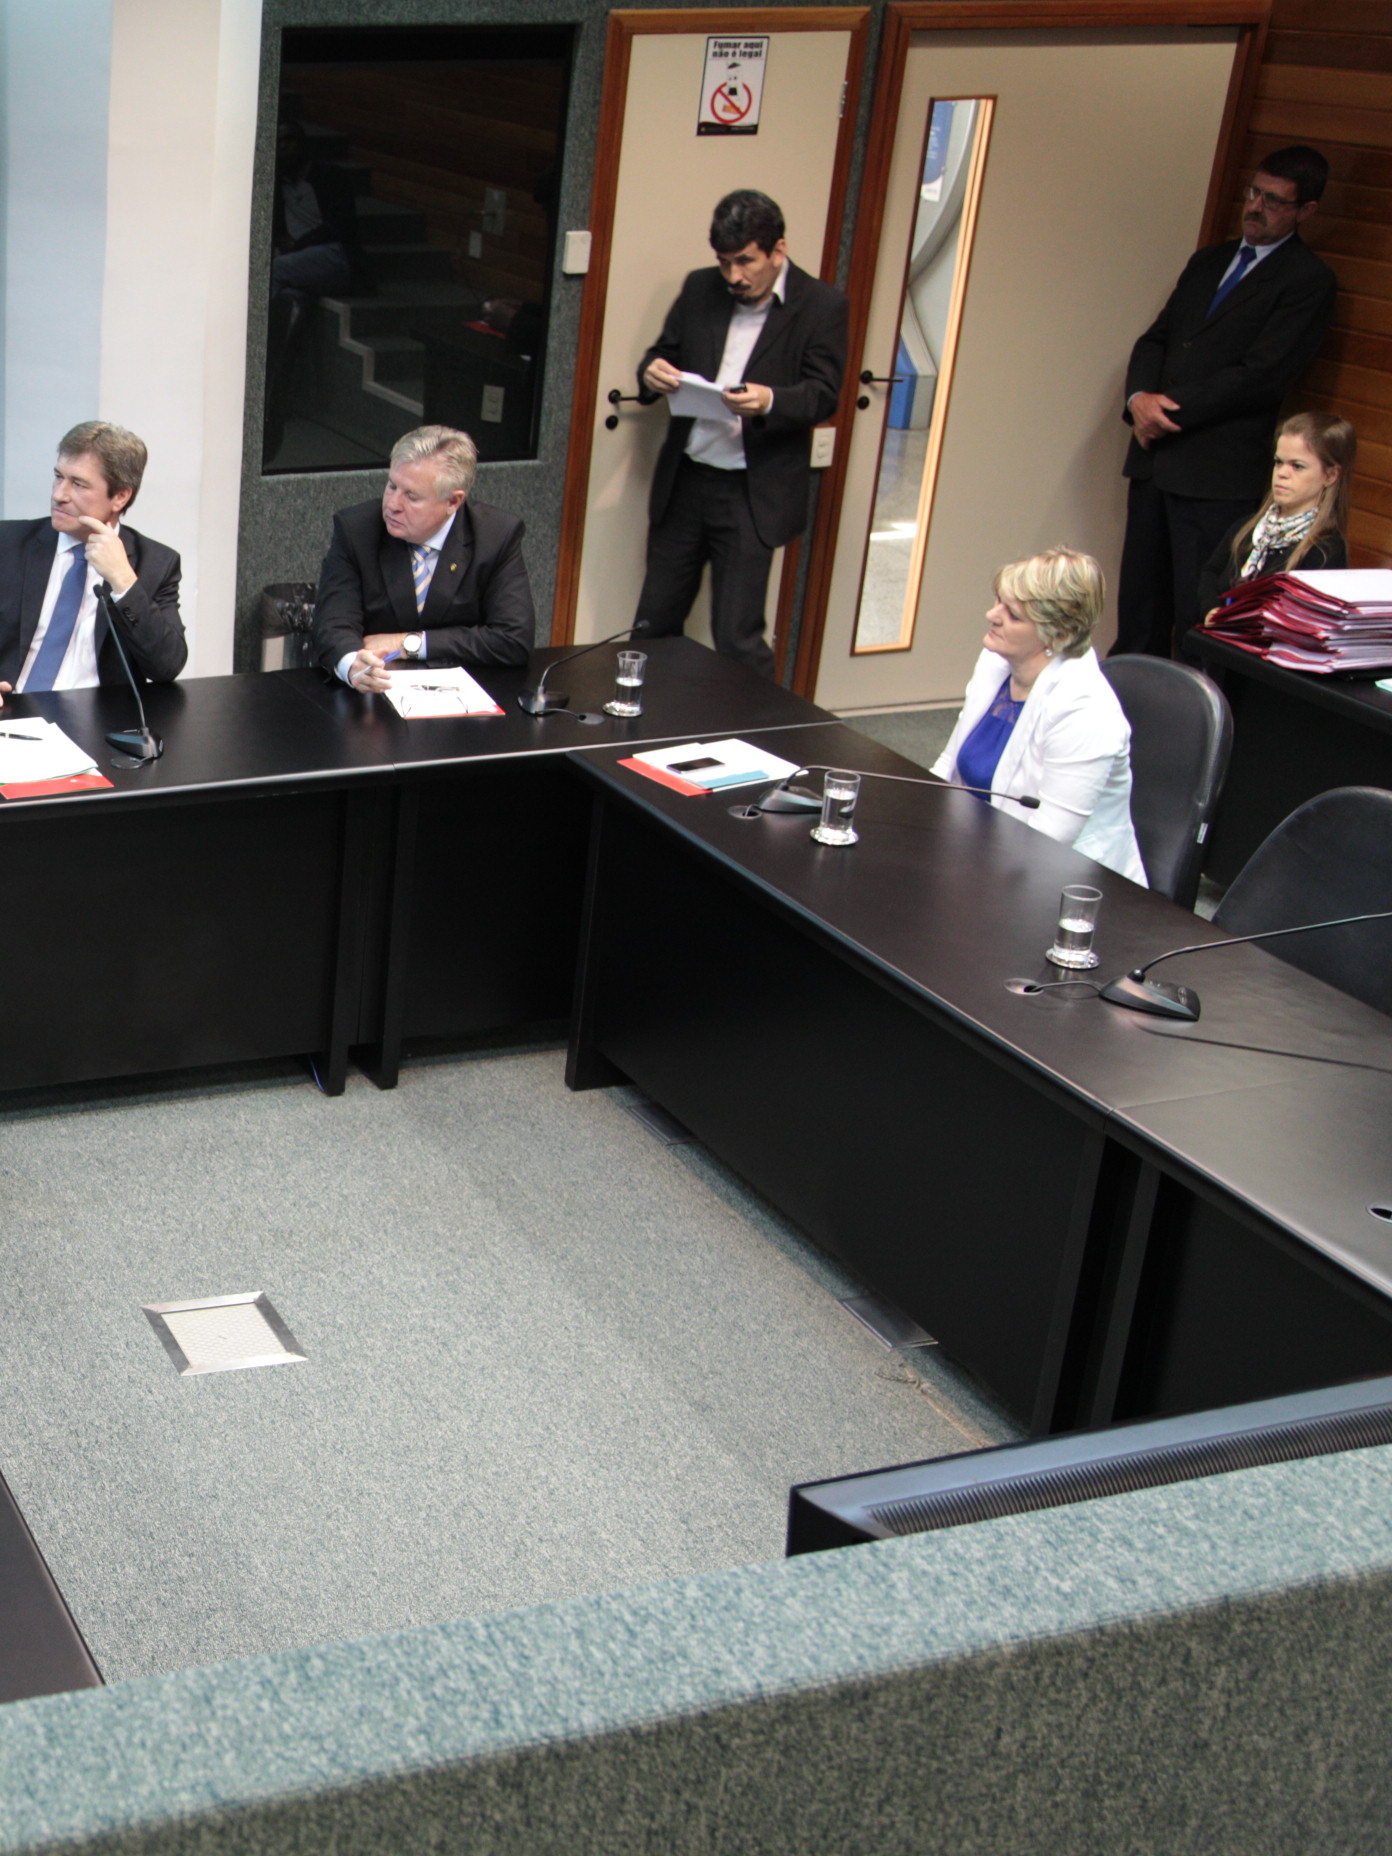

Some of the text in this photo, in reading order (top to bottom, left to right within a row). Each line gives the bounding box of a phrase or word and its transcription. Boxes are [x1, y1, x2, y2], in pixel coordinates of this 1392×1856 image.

[713, 41, 763, 49] Fumar aqui
[739, 50, 762, 58] legal
